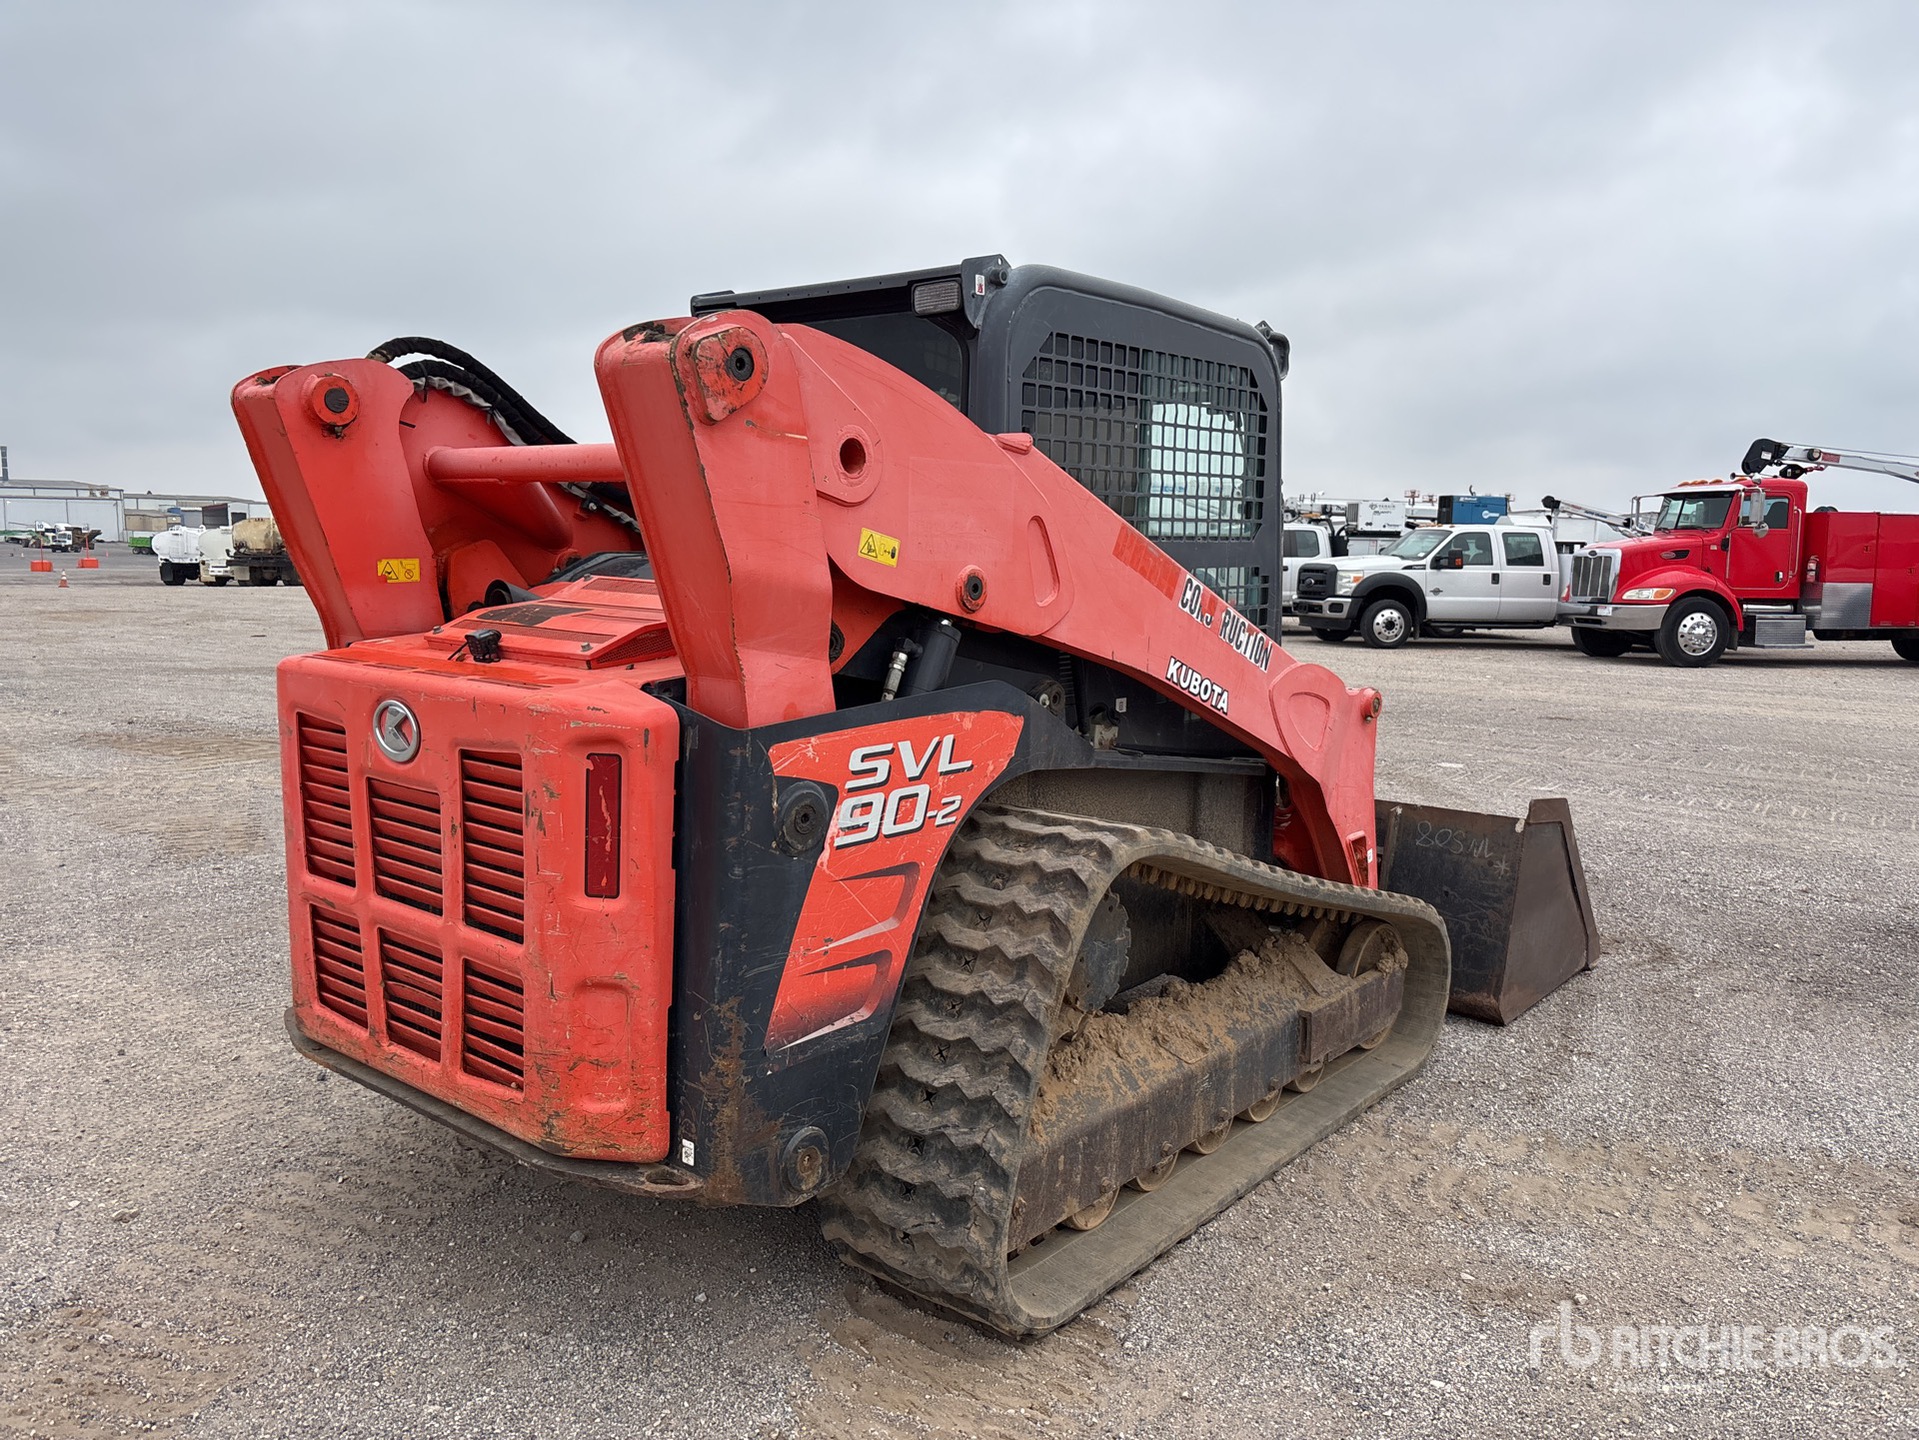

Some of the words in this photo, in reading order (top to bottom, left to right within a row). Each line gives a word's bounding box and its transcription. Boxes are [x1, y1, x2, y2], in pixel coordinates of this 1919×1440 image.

[1165, 656, 1229, 714] KUBOTA
[844, 734, 974, 792] SVL
[834, 783, 963, 849] 90-2
